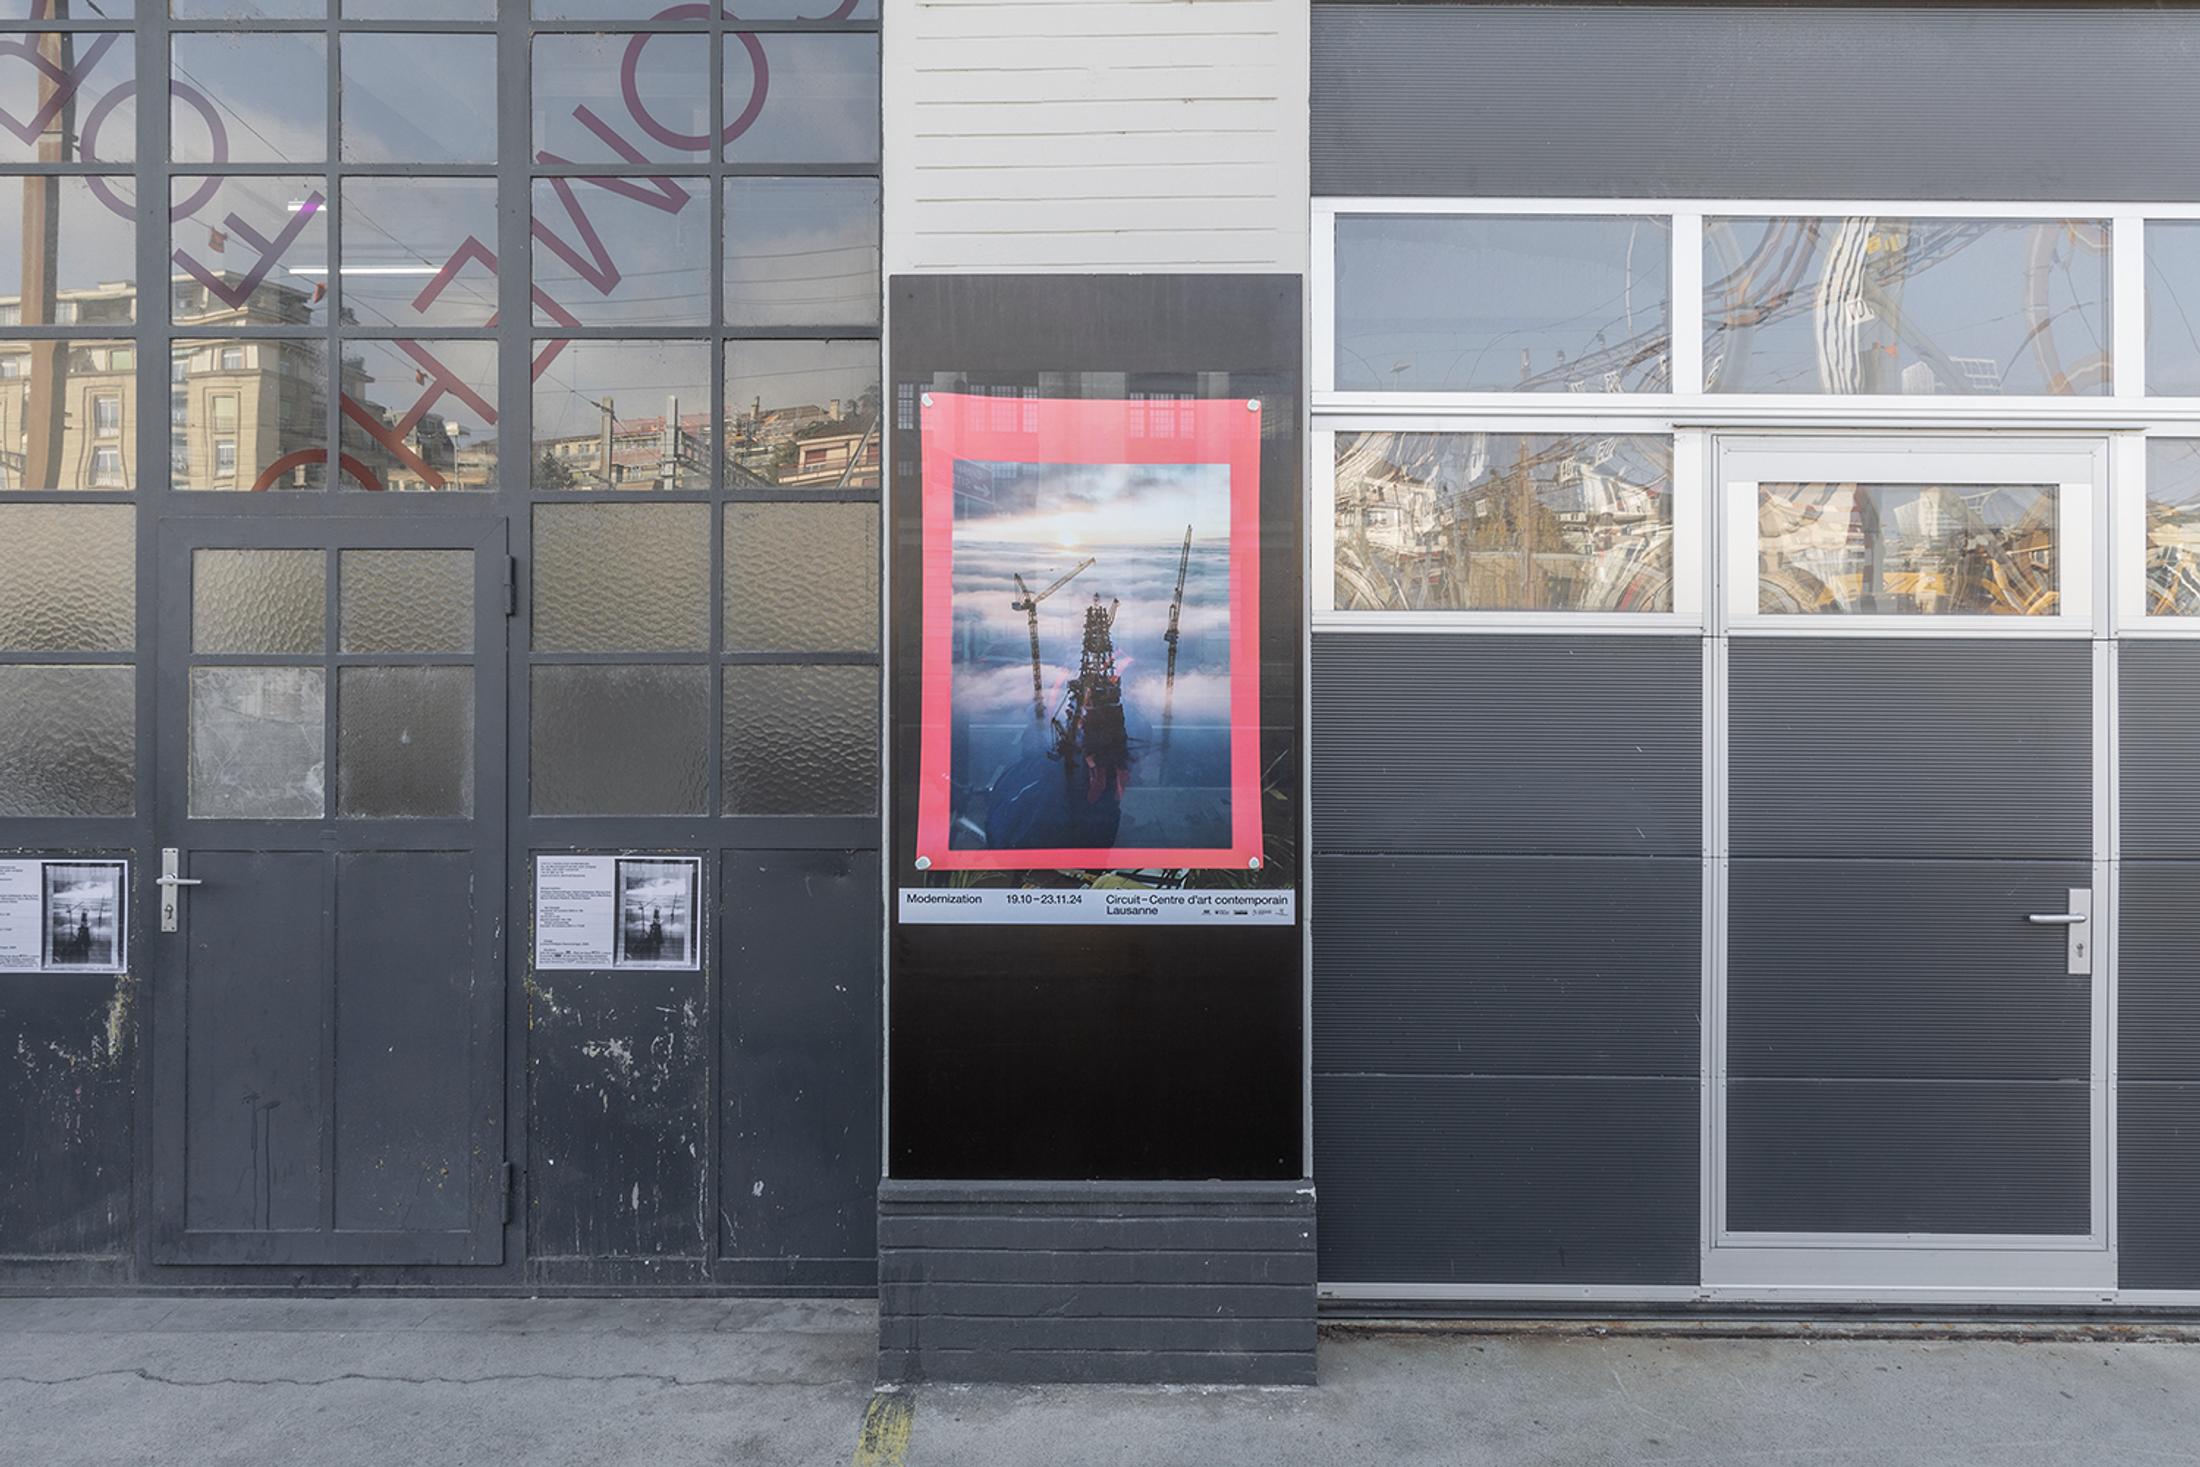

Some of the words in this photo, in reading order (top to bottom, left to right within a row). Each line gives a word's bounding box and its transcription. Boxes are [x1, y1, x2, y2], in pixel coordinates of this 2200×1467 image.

[906, 894, 982, 904] Modernization
[1187, 894, 1212, 905] d'art
[1215, 895, 1288, 906] contemporain
[1106, 906, 1158, 915] Lausanne
